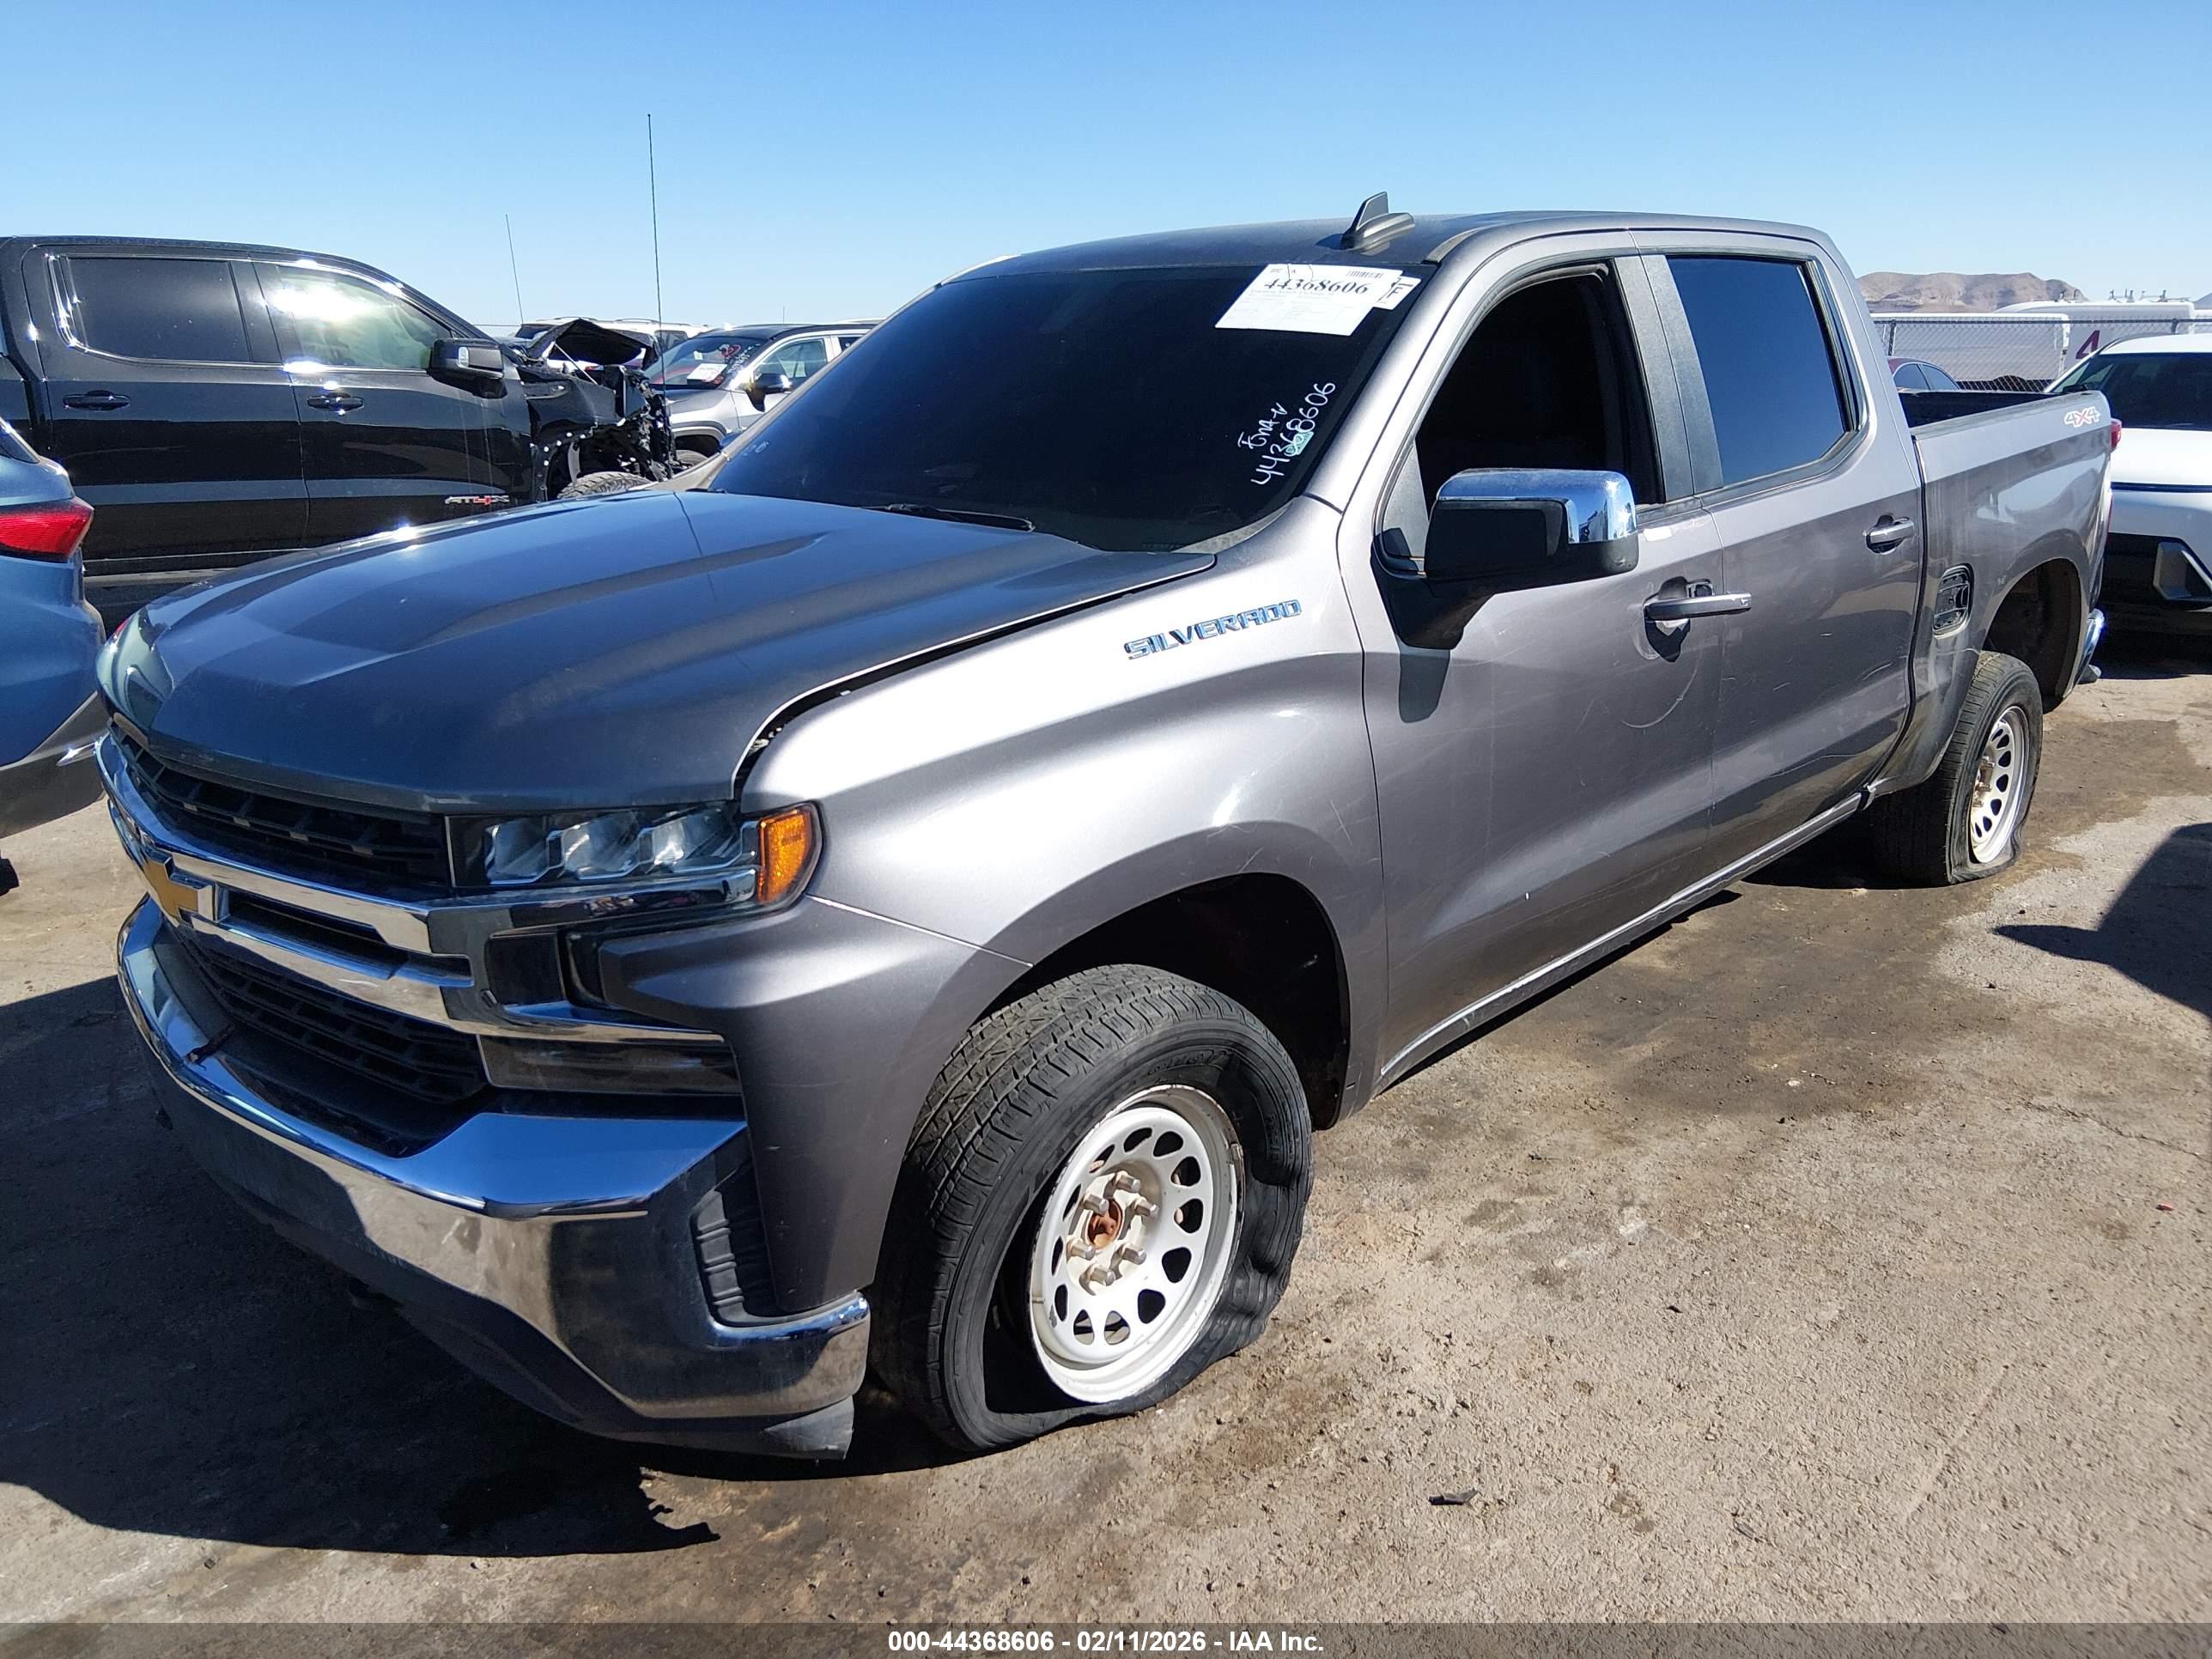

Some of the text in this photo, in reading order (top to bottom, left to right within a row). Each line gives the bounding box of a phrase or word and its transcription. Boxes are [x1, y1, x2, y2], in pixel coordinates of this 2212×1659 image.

[1264, 278, 1372, 295] 44368606
[1250, 383, 1336, 484] 44368606
[1124, 599, 1302, 659] SILVERADO
